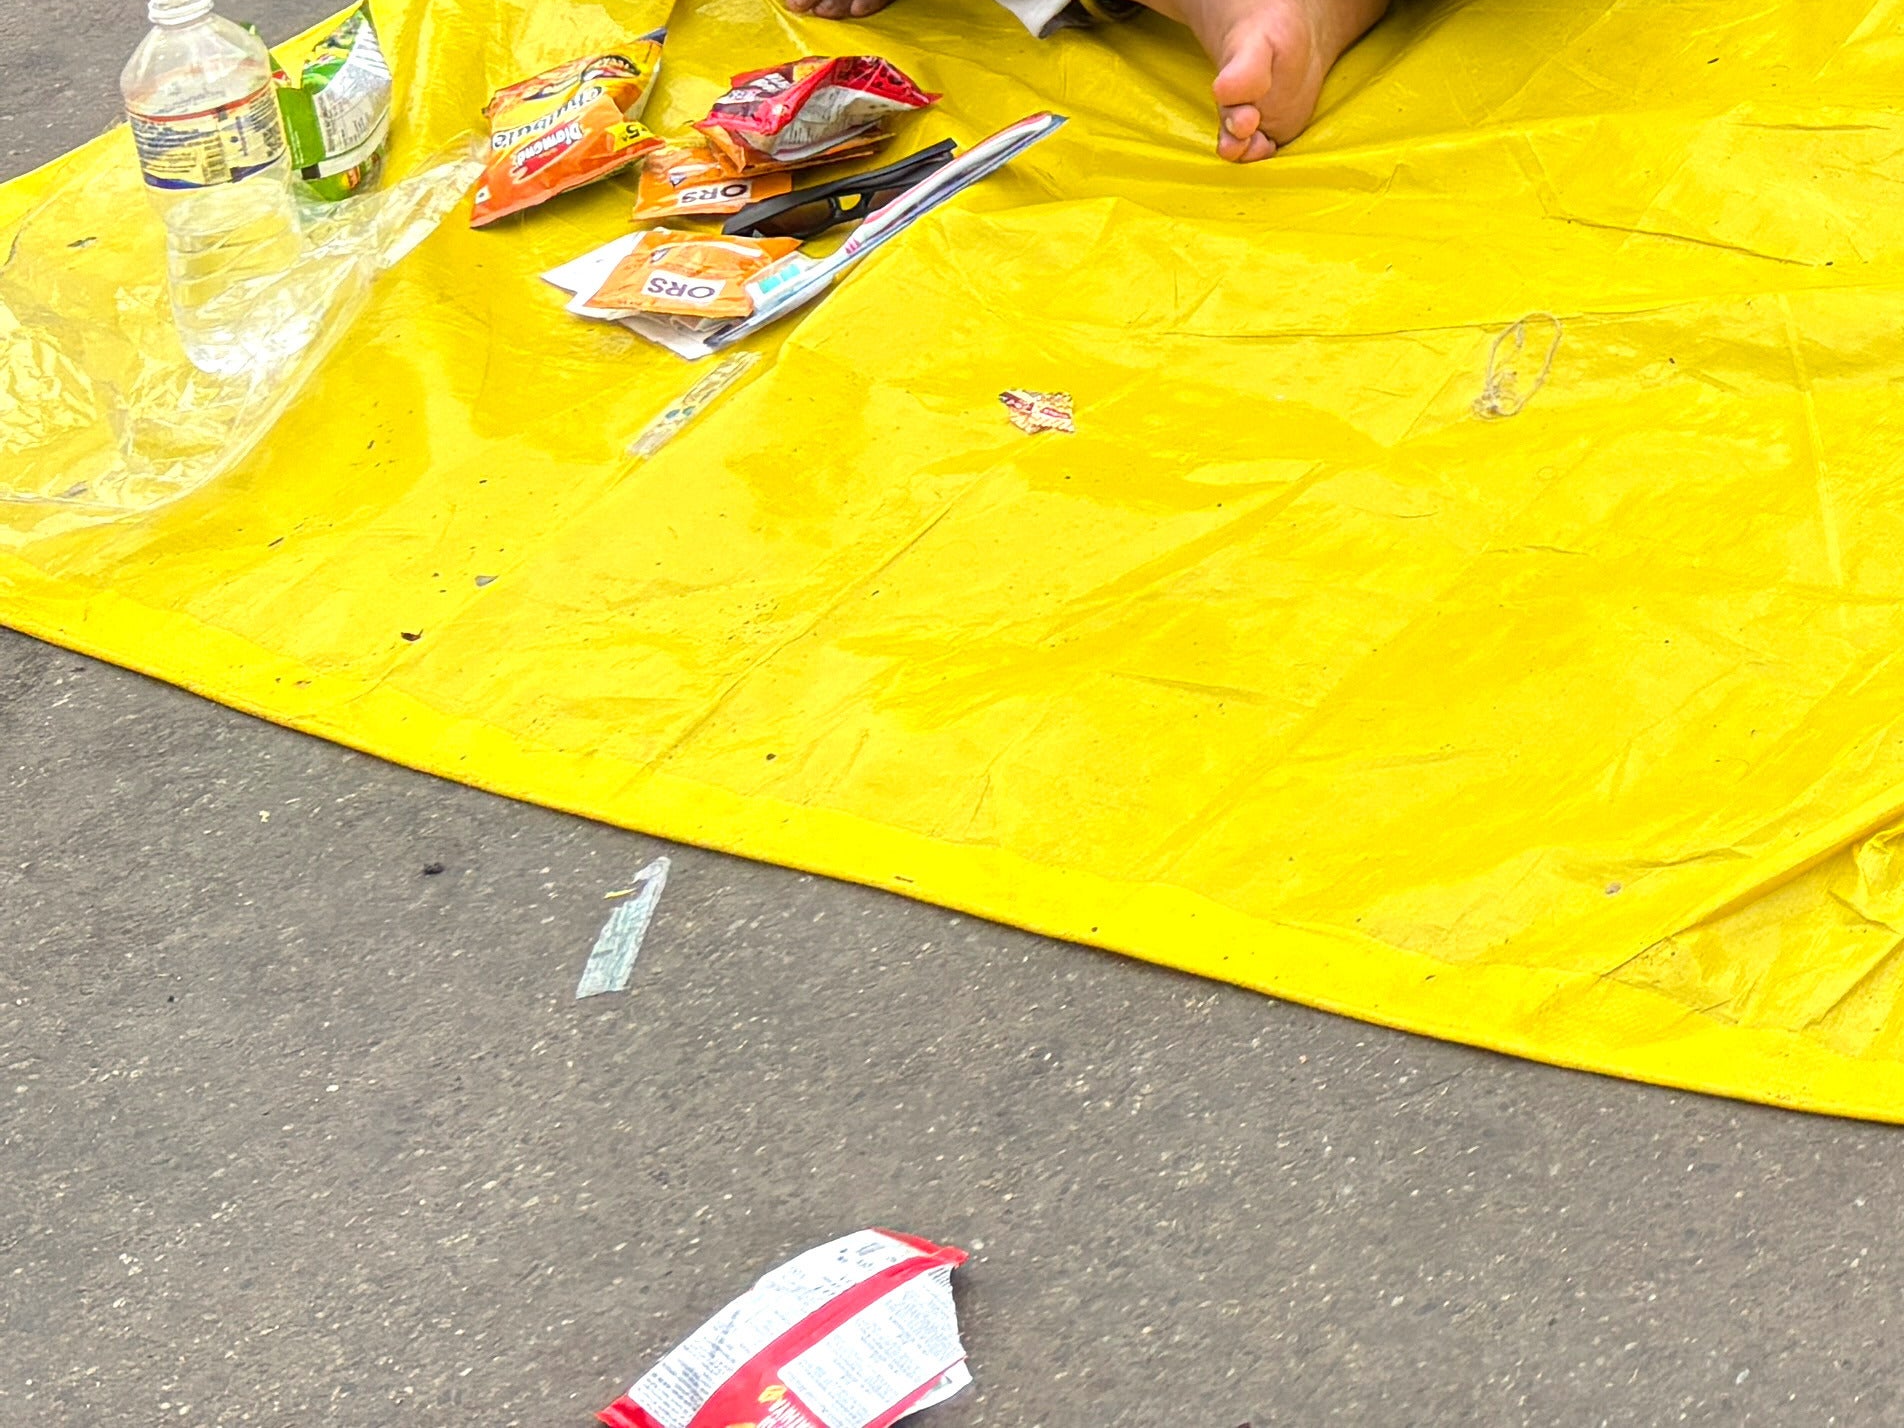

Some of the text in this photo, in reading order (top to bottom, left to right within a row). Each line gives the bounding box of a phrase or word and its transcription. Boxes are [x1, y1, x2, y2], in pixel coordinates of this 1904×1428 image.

[514, 120, 585, 168] Diamond
[680, 183, 749, 205] ORS
[646, 276, 716, 301] ORS
